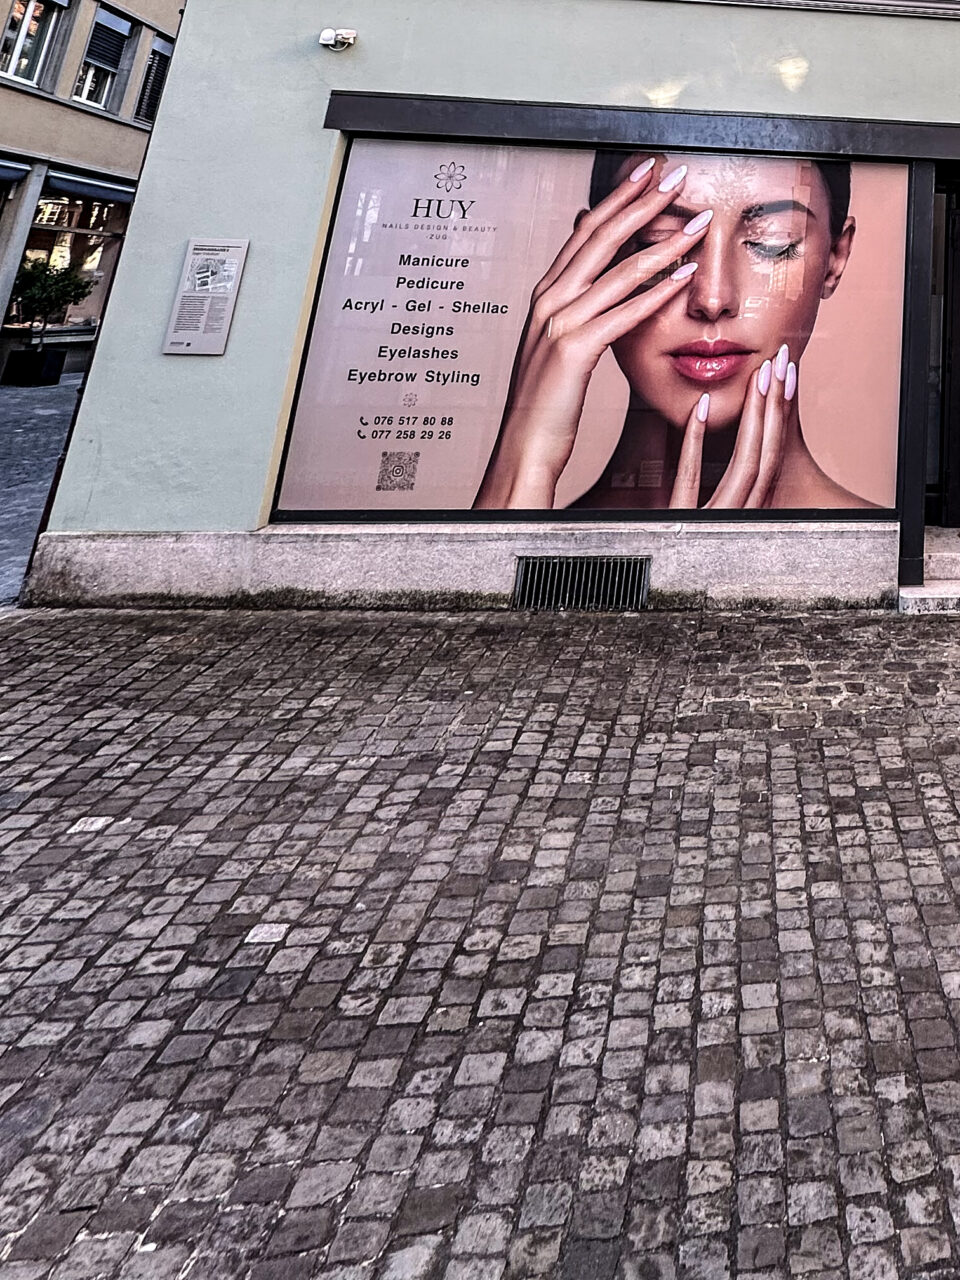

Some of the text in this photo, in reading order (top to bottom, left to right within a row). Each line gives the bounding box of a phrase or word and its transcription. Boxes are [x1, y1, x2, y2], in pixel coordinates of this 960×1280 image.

[410, 198, 476, 220] HUY
[413, 223, 449, 231] DESIGN
[398, 254, 470, 268] Manicure
[395, 276, 465, 290] Pedicure
[341, 298, 385, 314] Acryl
[405, 299, 432, 312] Gel
[451, 300, 509, 315] Shellac
[390, 322, 454, 338] Designs
[377, 345, 459, 361] Eyelashes
[347, 369, 481, 386] Eyebrow Styling
[373, 416, 454, 426] 076 517 80 88
[371, 430, 452, 440] 077 258 29 26
